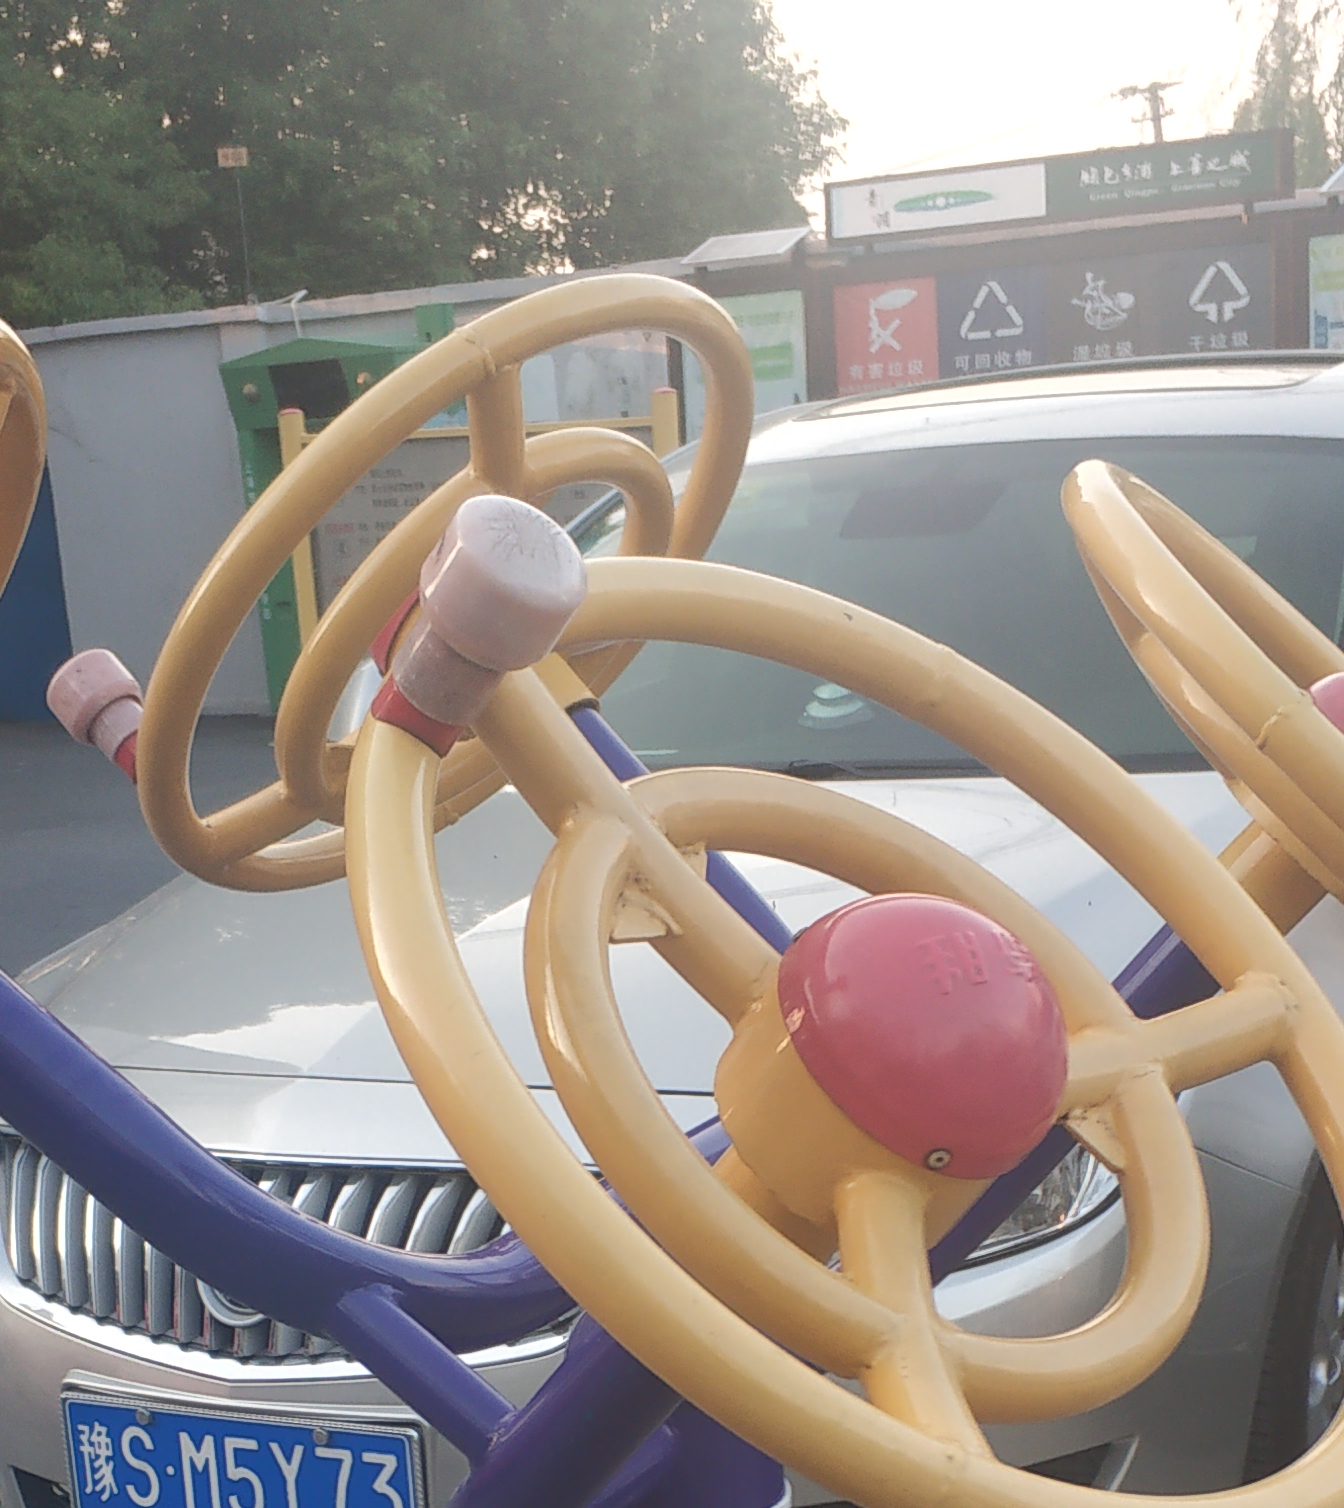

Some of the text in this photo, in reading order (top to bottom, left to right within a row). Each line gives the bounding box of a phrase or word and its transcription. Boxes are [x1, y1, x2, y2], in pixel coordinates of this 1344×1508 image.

[1073, 341, 1134, 361] 湿垃圾
[1189, 330, 1250, 351] 干垃圾
[849, 359, 924, 380] 有害垃圾
[954, 348, 1033, 371] 可回收物
